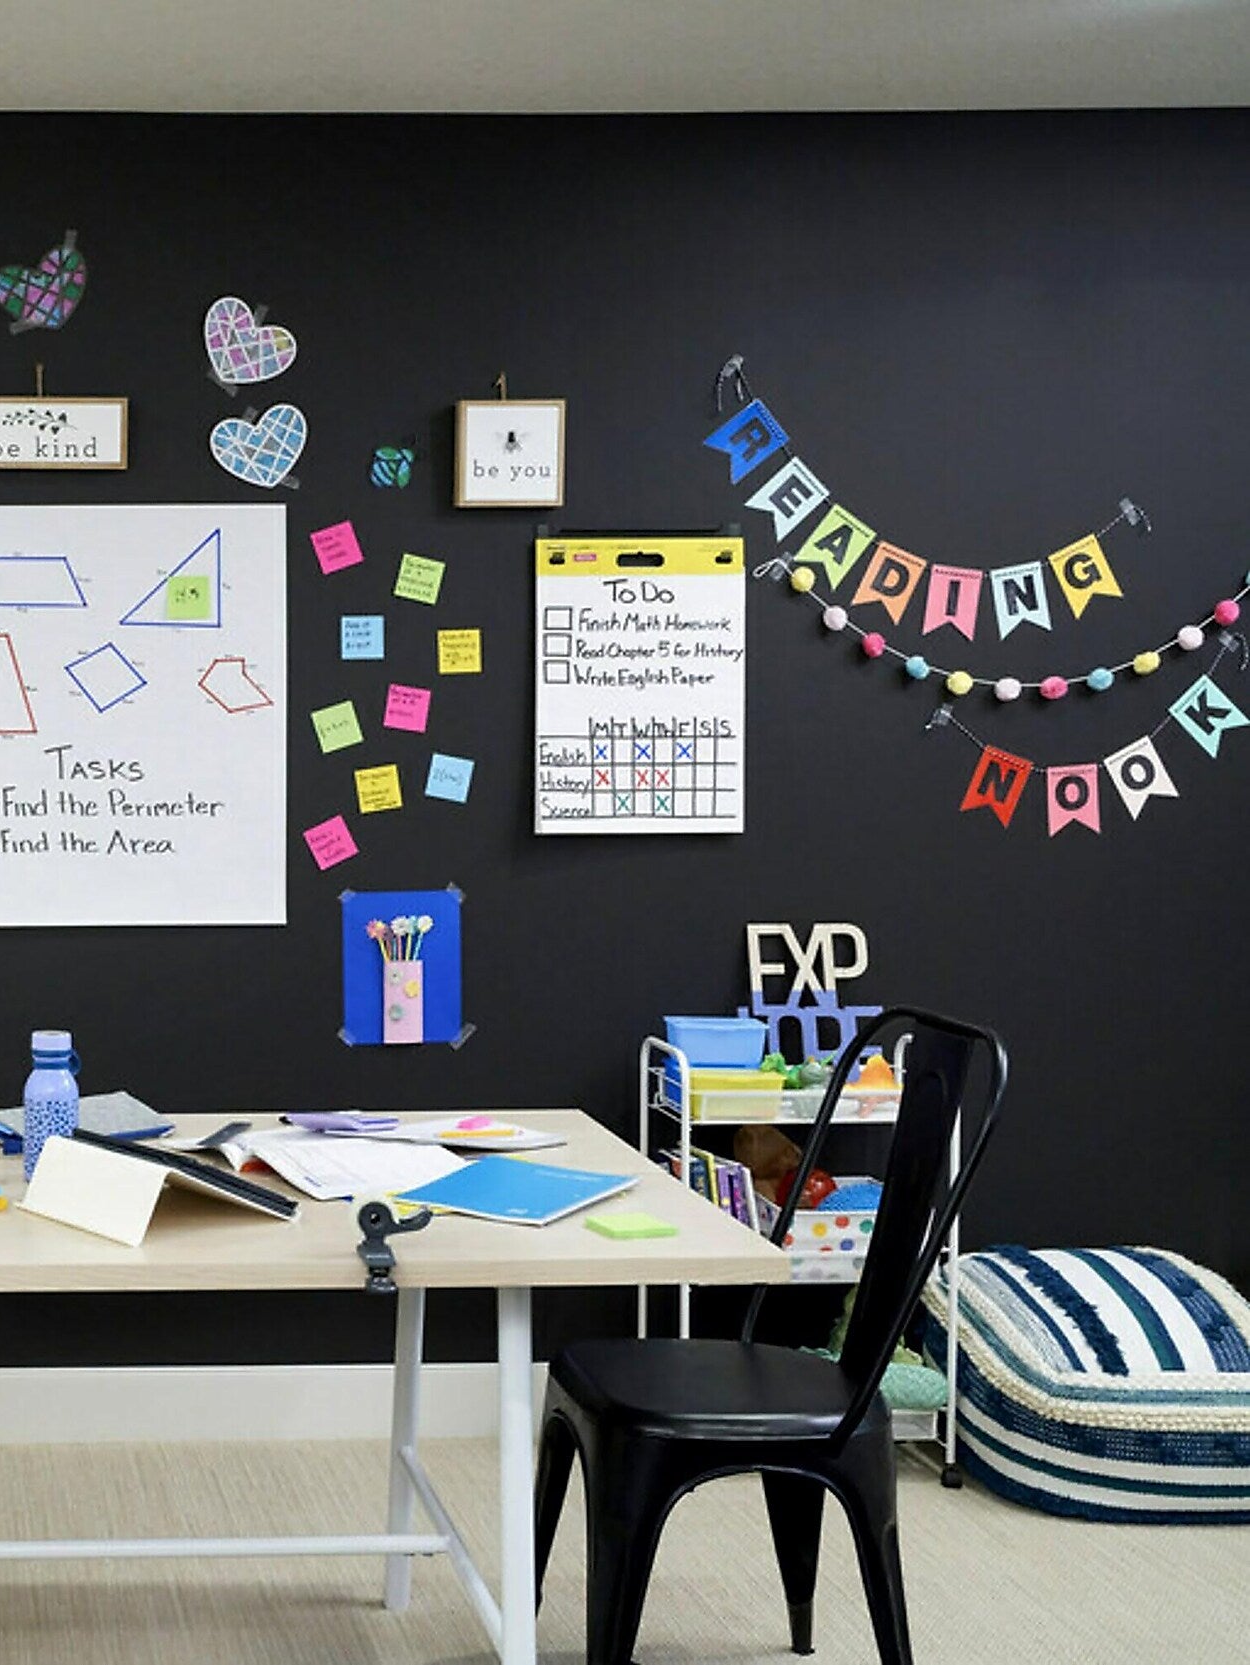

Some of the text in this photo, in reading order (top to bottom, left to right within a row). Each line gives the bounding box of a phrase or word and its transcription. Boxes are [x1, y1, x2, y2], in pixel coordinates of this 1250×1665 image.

[35, 436, 98, 458] kind
[473, 460, 551, 481] be you
[728, 417, 1103, 616] READING
[602, 578, 675, 604] To Do
[578, 607, 732, 633] Finish Math Homework
[576, 640, 743, 662] Read Chapter 5 for History
[573, 664, 715, 689] Write English Paper
[594, 722, 609, 738] M
[614, 722, 628, 737] T
[634, 722, 650, 738] W
[678, 722, 691, 736] F
[699, 721, 712, 737] S
[720, 720, 733, 737] S
[539, 743, 587, 765] English
[975, 688, 1232, 812] NOOK
[540, 771, 591, 799] History
[1, 785, 226, 818] Find the Perimeter
[541, 798, 591, 817] Science
[0, 827, 176, 855] Find the Area
[746, 922, 869, 1017] EXP
